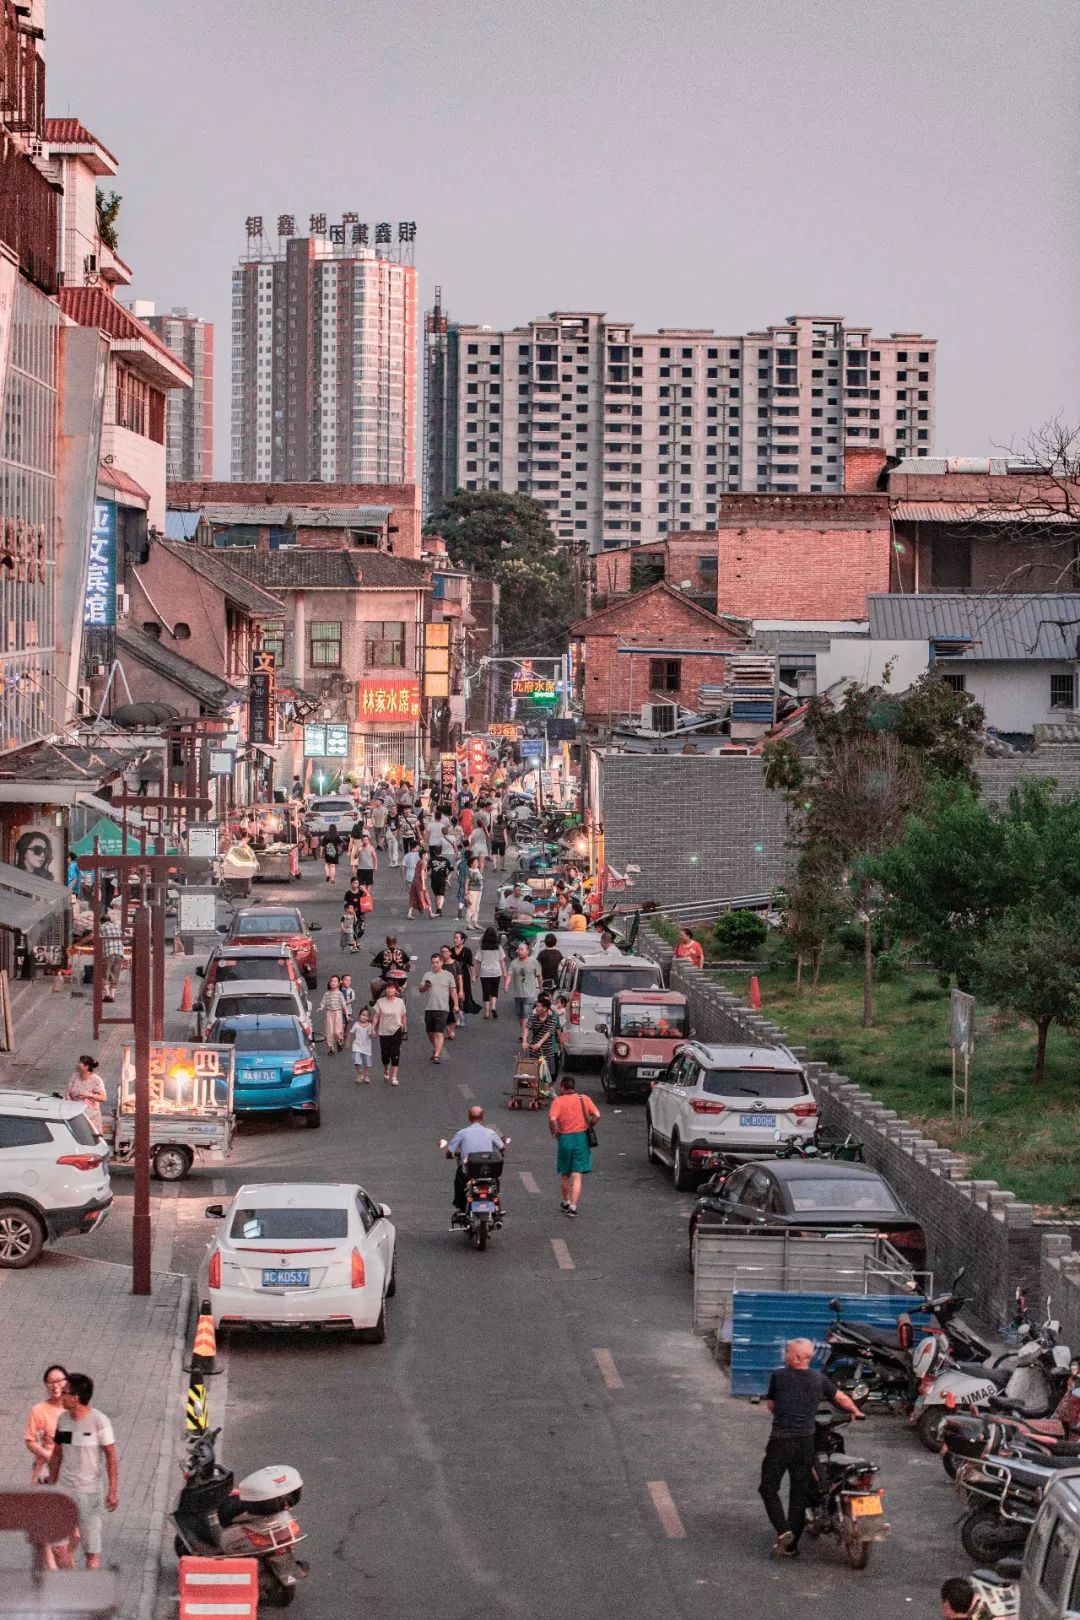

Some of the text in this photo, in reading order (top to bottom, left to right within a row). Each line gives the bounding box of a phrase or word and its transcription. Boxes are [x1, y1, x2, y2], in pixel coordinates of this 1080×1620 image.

[245, 211, 359, 237] 银鑫地产
[362, 689, 410, 714] 林家水席
